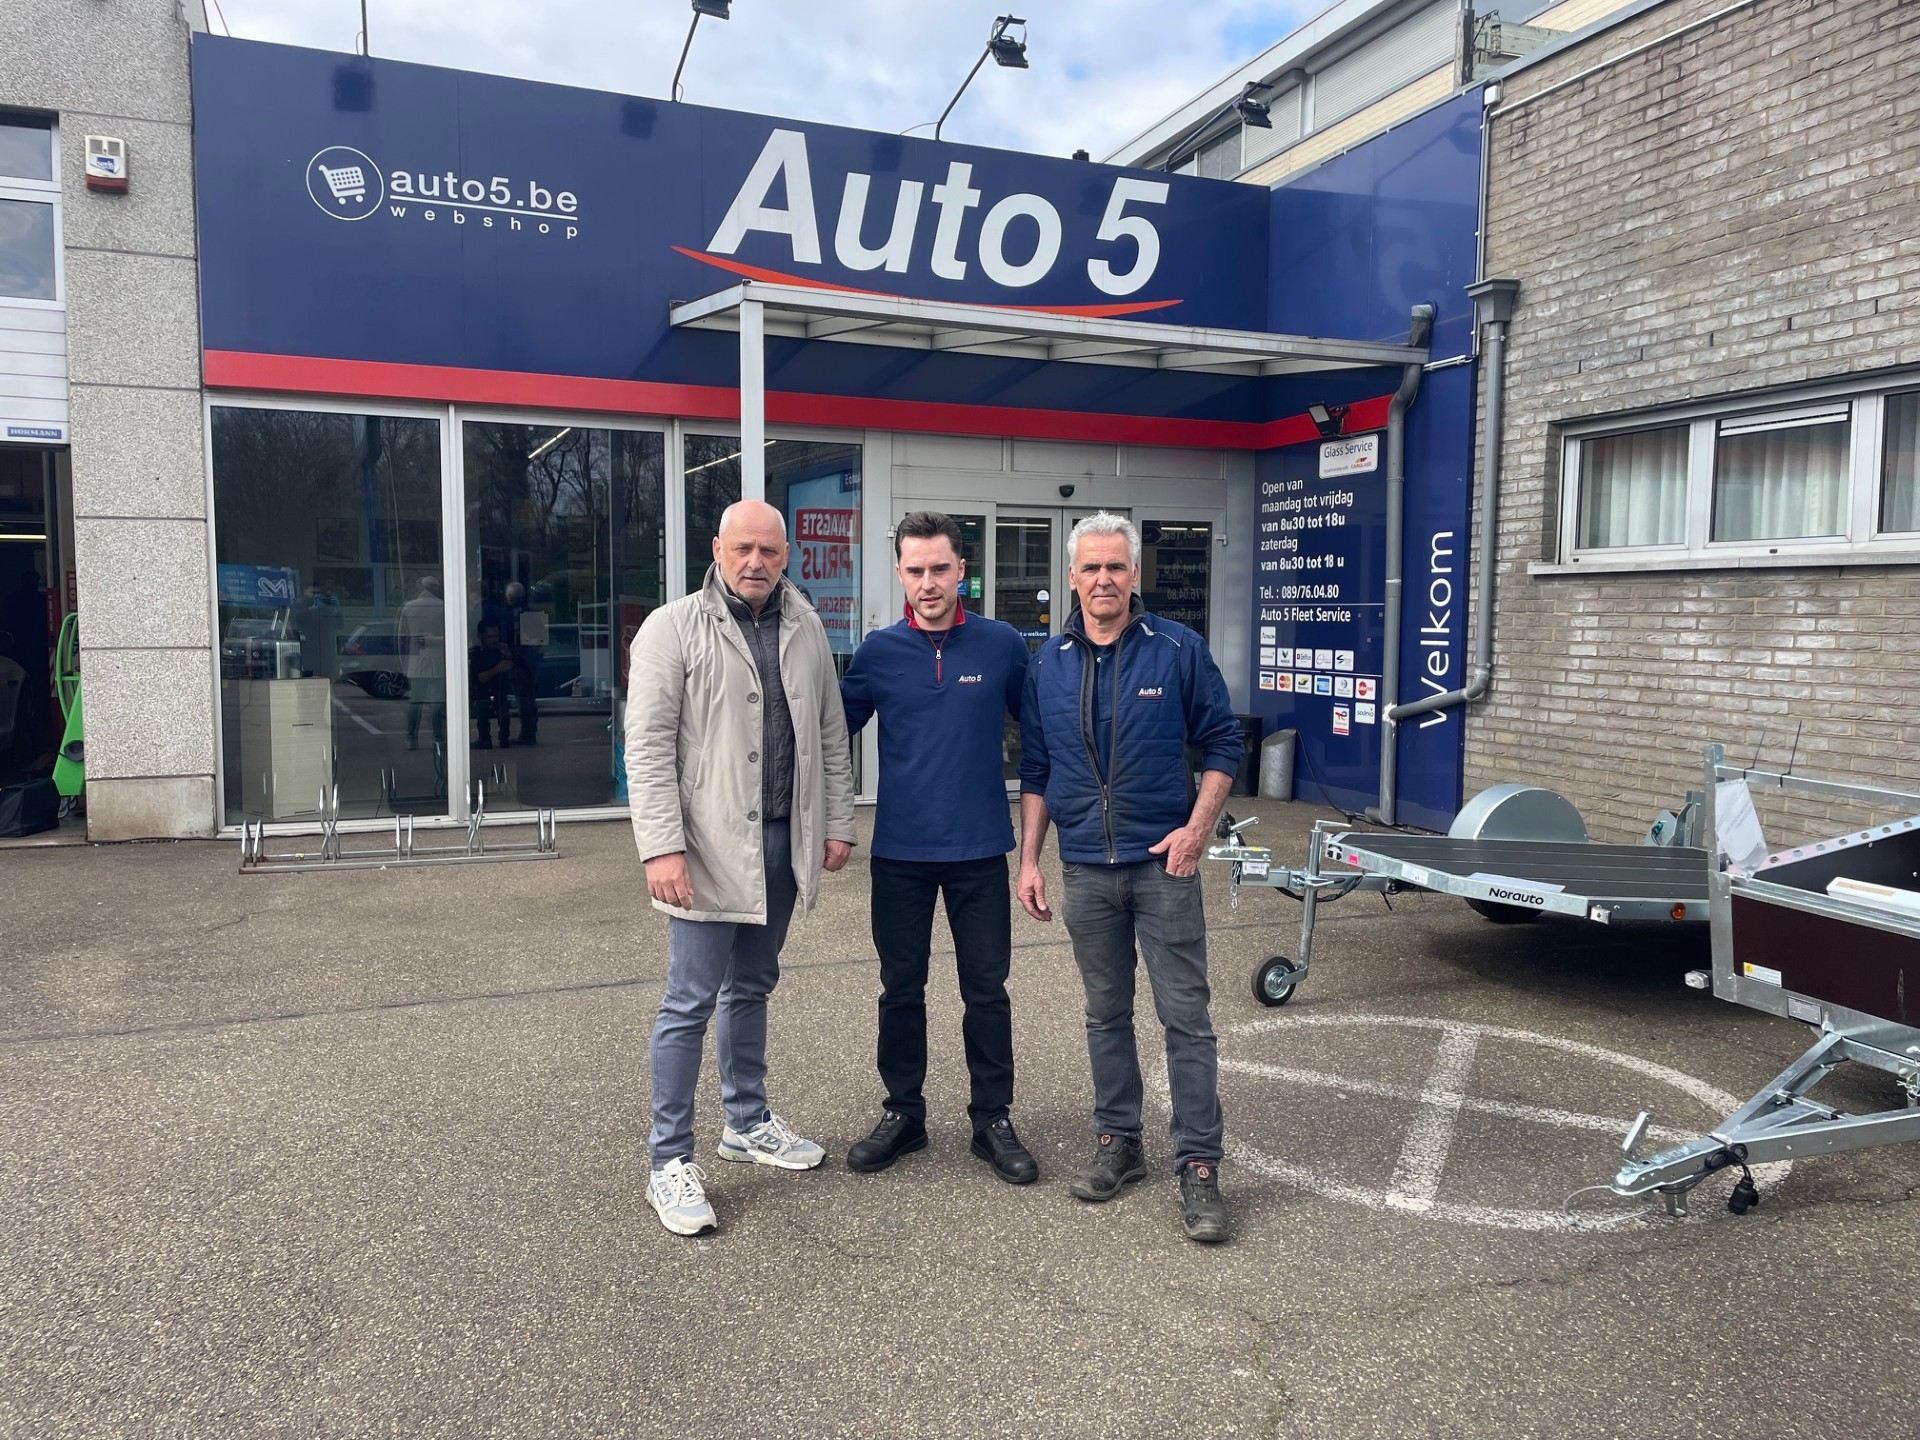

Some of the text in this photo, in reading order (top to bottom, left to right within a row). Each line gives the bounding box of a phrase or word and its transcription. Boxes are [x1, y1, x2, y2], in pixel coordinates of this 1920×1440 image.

[390, 169, 578, 212] auto5.be
[705, 128, 1170, 296] Auto 5
[1324, 441, 1373, 458] Glass Service
[1262, 480, 1303, 497] Open van
[1262, 490, 1353, 513] maandag tot vrijdag
[1262, 513, 1345, 532] van 8u30 tot 18u
[1261, 536, 1298, 552] zaterdag
[1261, 554, 1344, 571] van 8u30 tot 18 u
[1259, 586, 1274, 599] Tel.
[1281, 584, 1339, 599] 089/76.04.80
[1260, 607, 1351, 622] Auto 5 Fleet Service
[1138, 687, 1156, 696] Auto
[1489, 887, 1544, 905] Norauto
